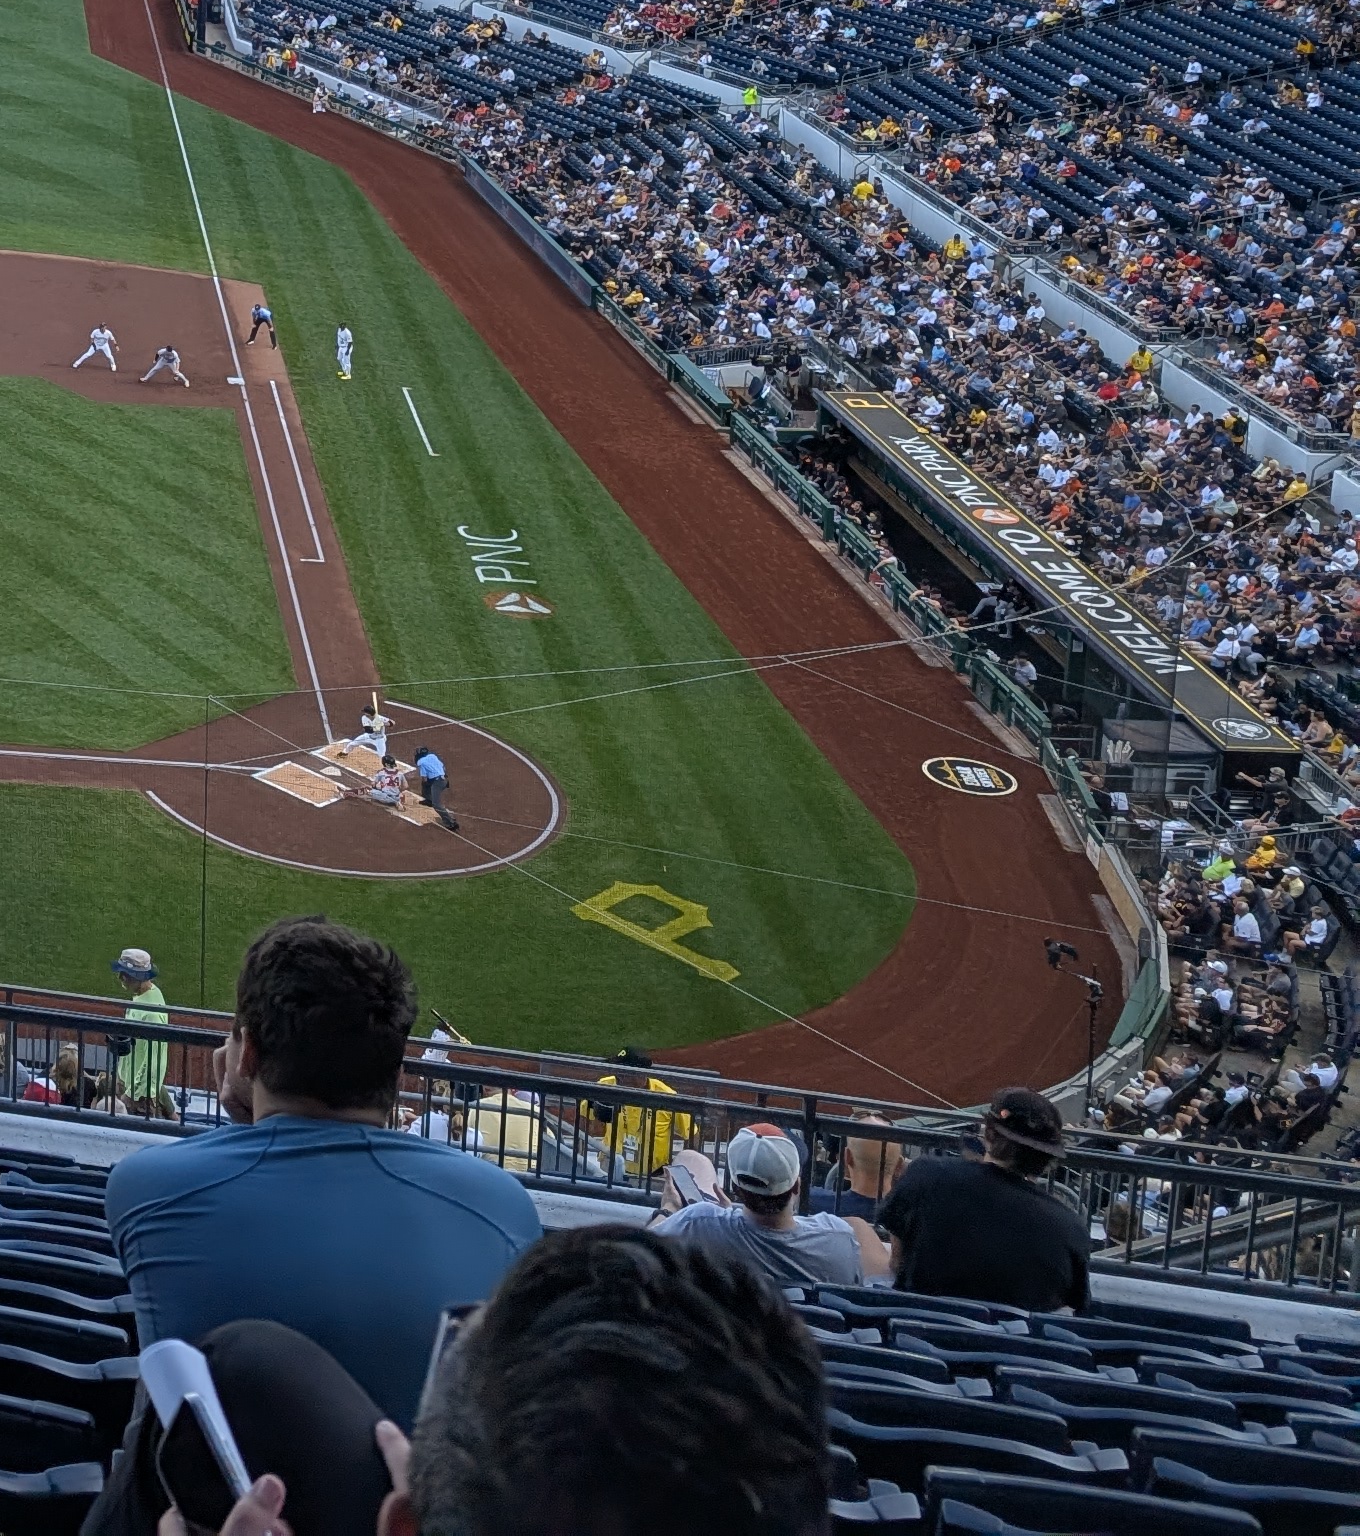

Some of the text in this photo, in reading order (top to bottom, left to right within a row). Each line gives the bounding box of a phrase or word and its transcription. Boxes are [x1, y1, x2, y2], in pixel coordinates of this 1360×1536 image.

[457, 525, 537, 584] PNC
[888, 434, 1196, 675] WELCOME TO PNC PARK
